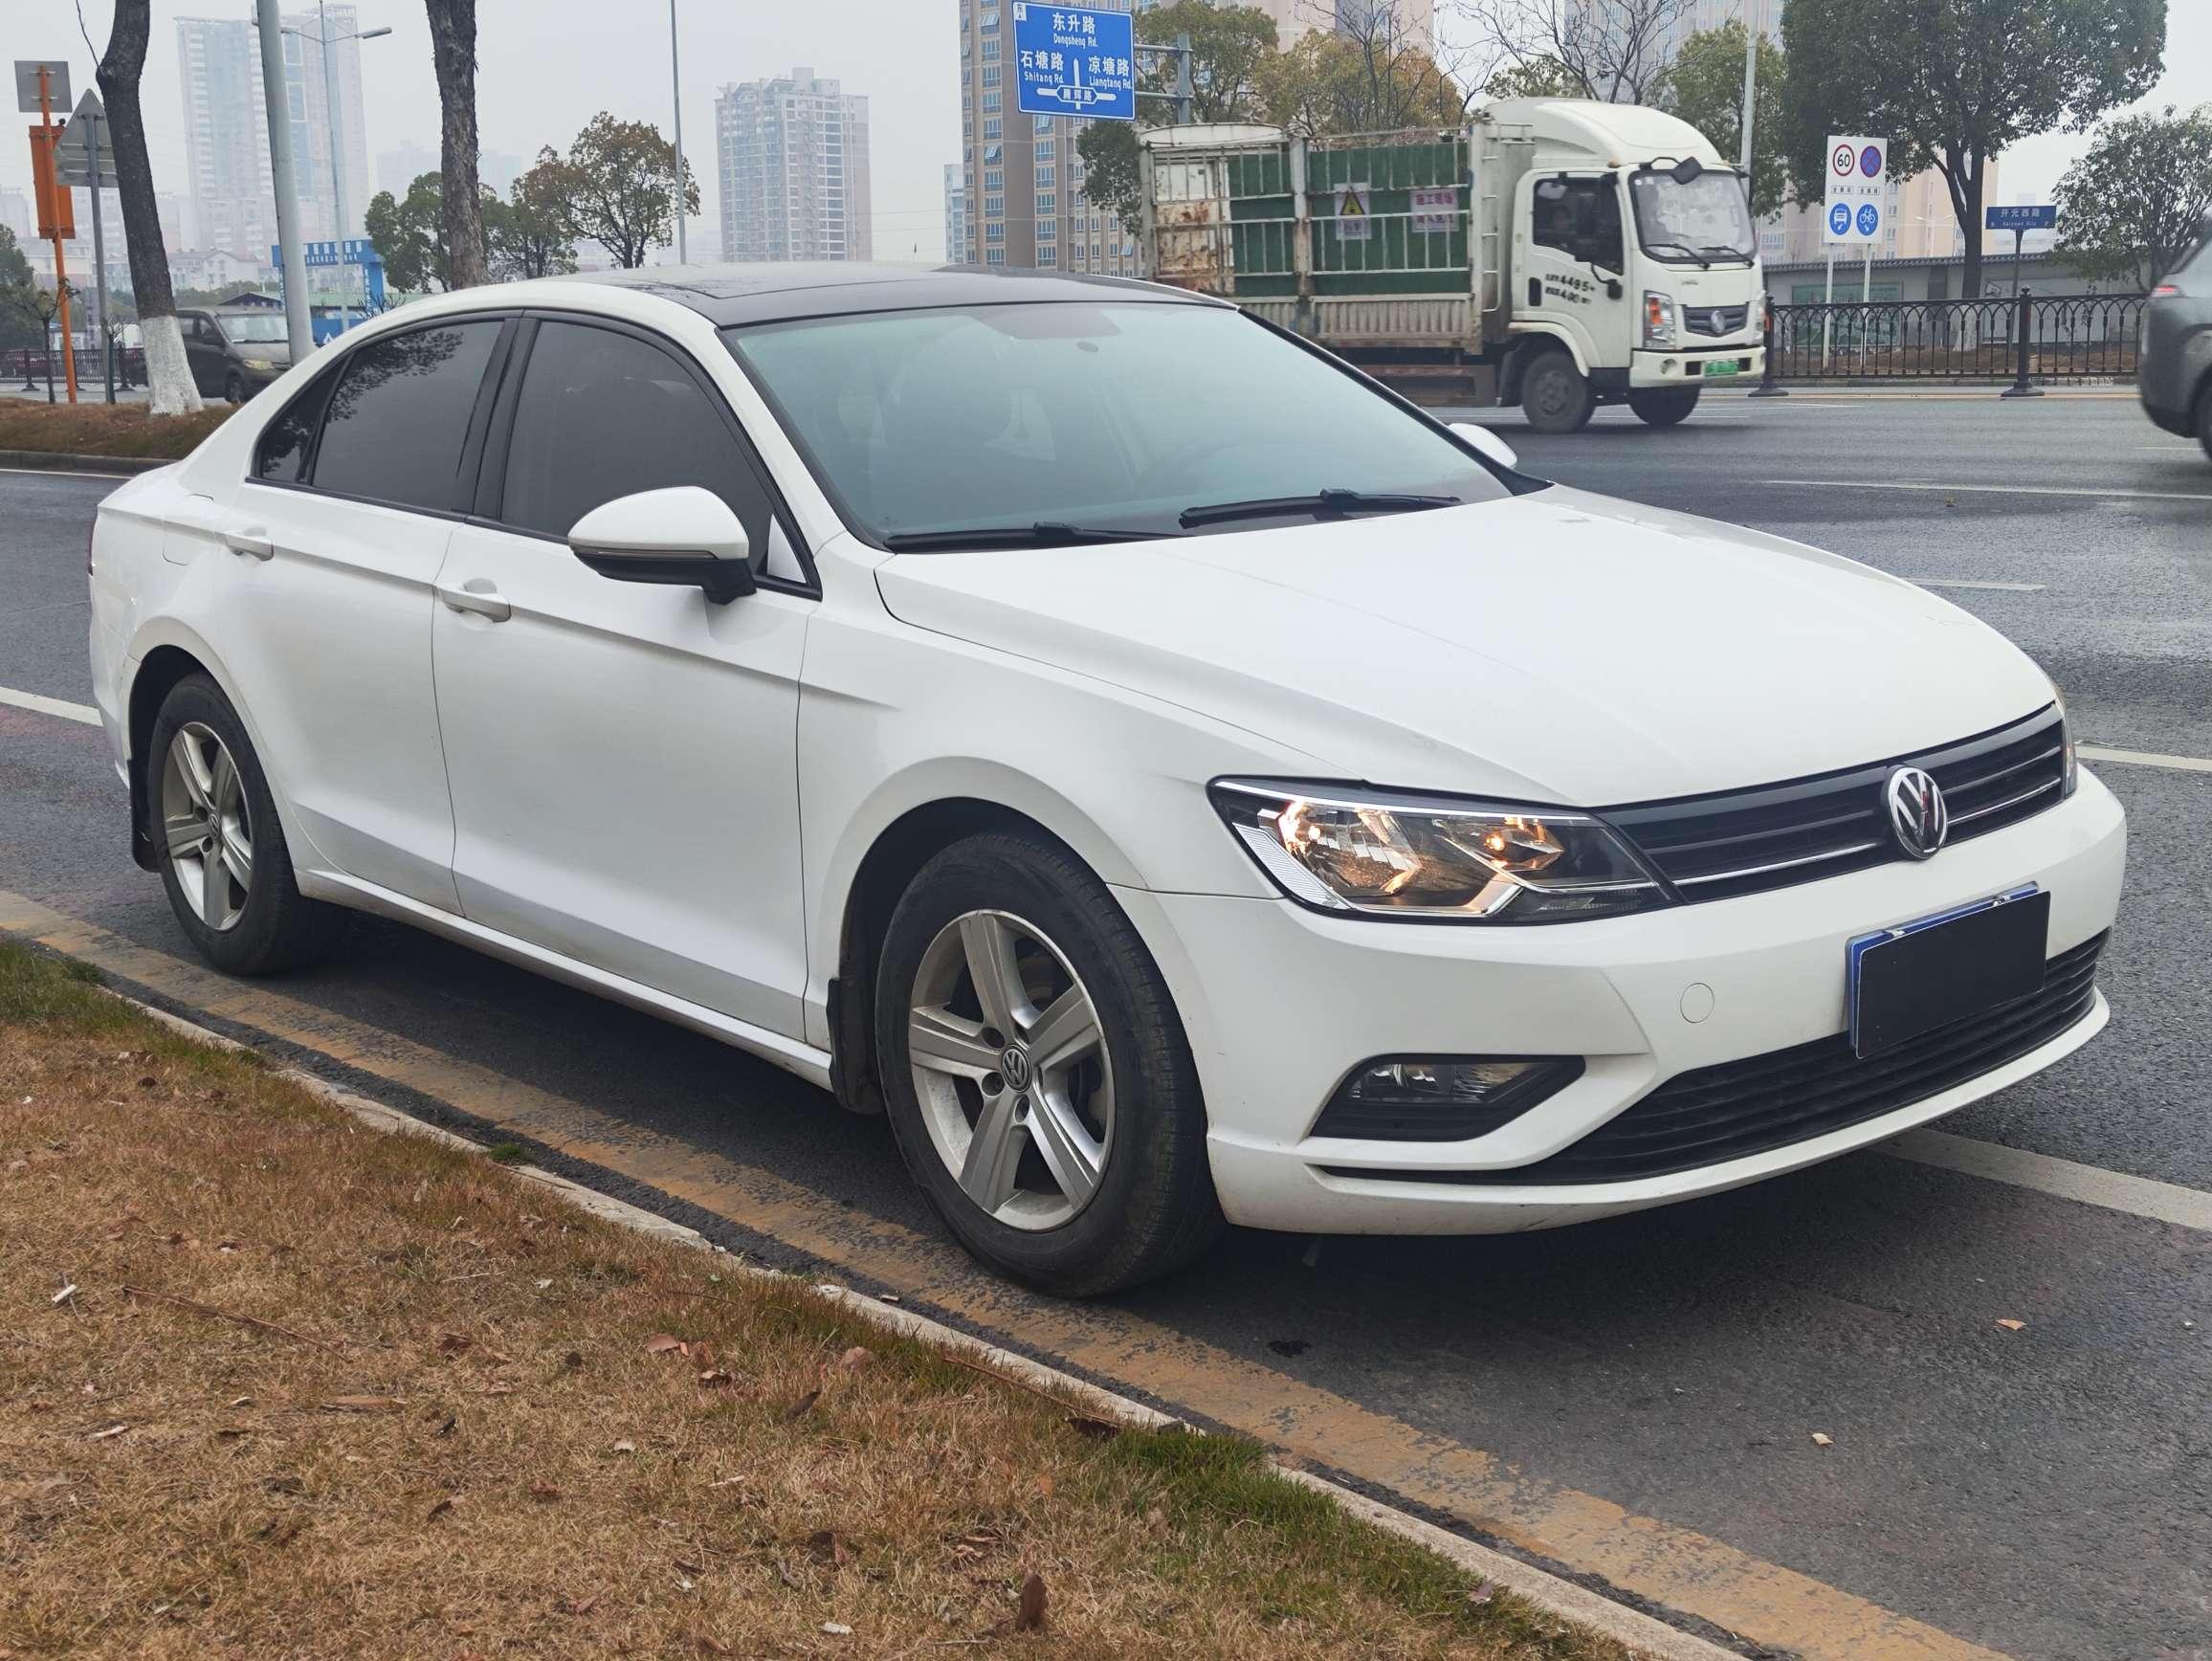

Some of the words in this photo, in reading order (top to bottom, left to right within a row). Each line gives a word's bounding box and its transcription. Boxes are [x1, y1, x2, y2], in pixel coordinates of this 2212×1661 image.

[1052, 11, 1095, 34] 东升路
[1053, 33, 1086, 49] Dongsheng
[1021, 50, 1064, 71] 石塘路
[1089, 55, 1129, 77] 凉塘路
[1024, 71, 1053, 86] Shitang
[1089, 76, 1121, 91] Liangtang
[1837, 153, 1850, 167] 60
[1002, 1048, 1032, 1092] VW
